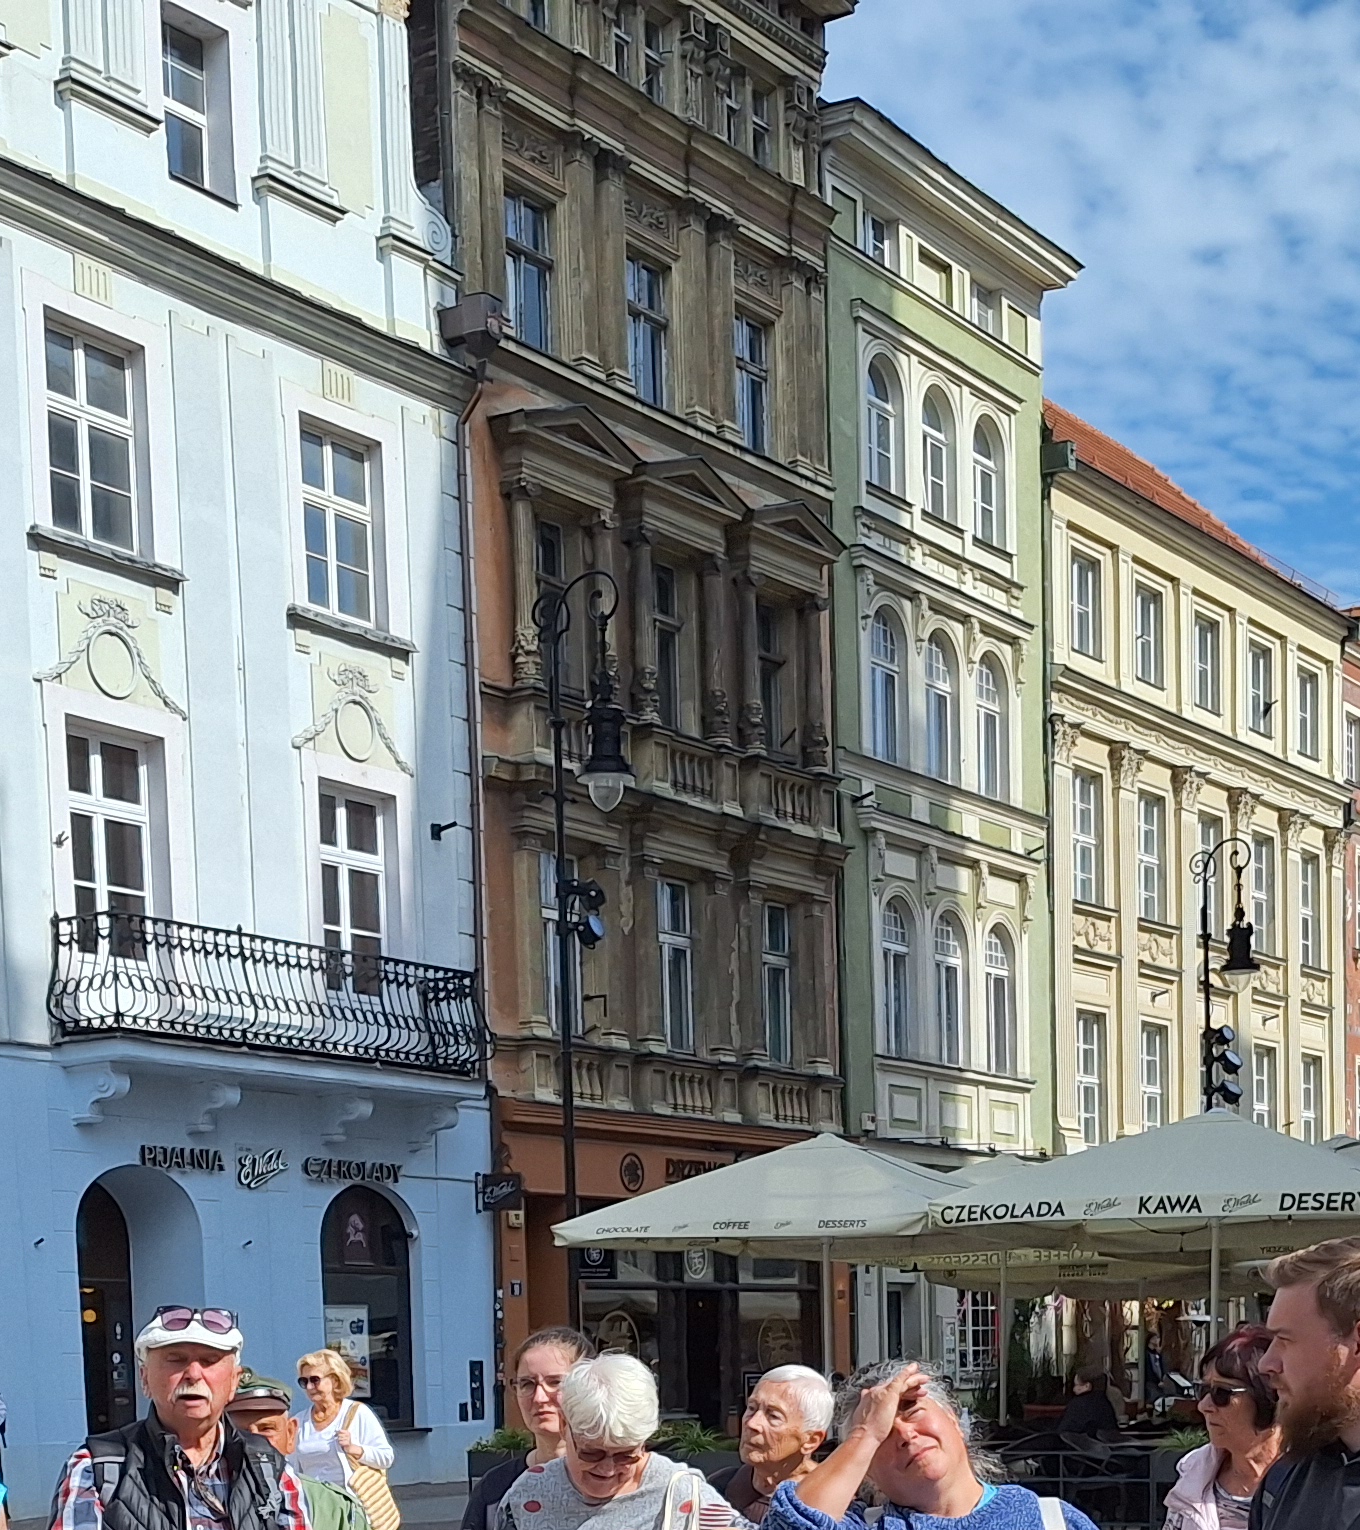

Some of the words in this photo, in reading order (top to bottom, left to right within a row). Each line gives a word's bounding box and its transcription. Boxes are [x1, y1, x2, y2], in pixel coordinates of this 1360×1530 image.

[140, 1144, 225, 1172] PIJALNIA
[302, 1156, 403, 1183] CZEKOLADY
[940, 1200, 1066, 1225] CZEKOLADA
[1137, 1195, 1202, 1215] KAWA
[595, 1225, 651, 1235] CHOCOLATE
[712, 1221, 751, 1231] COFFEE
[817, 1219, 868, 1229] DESSERTS
